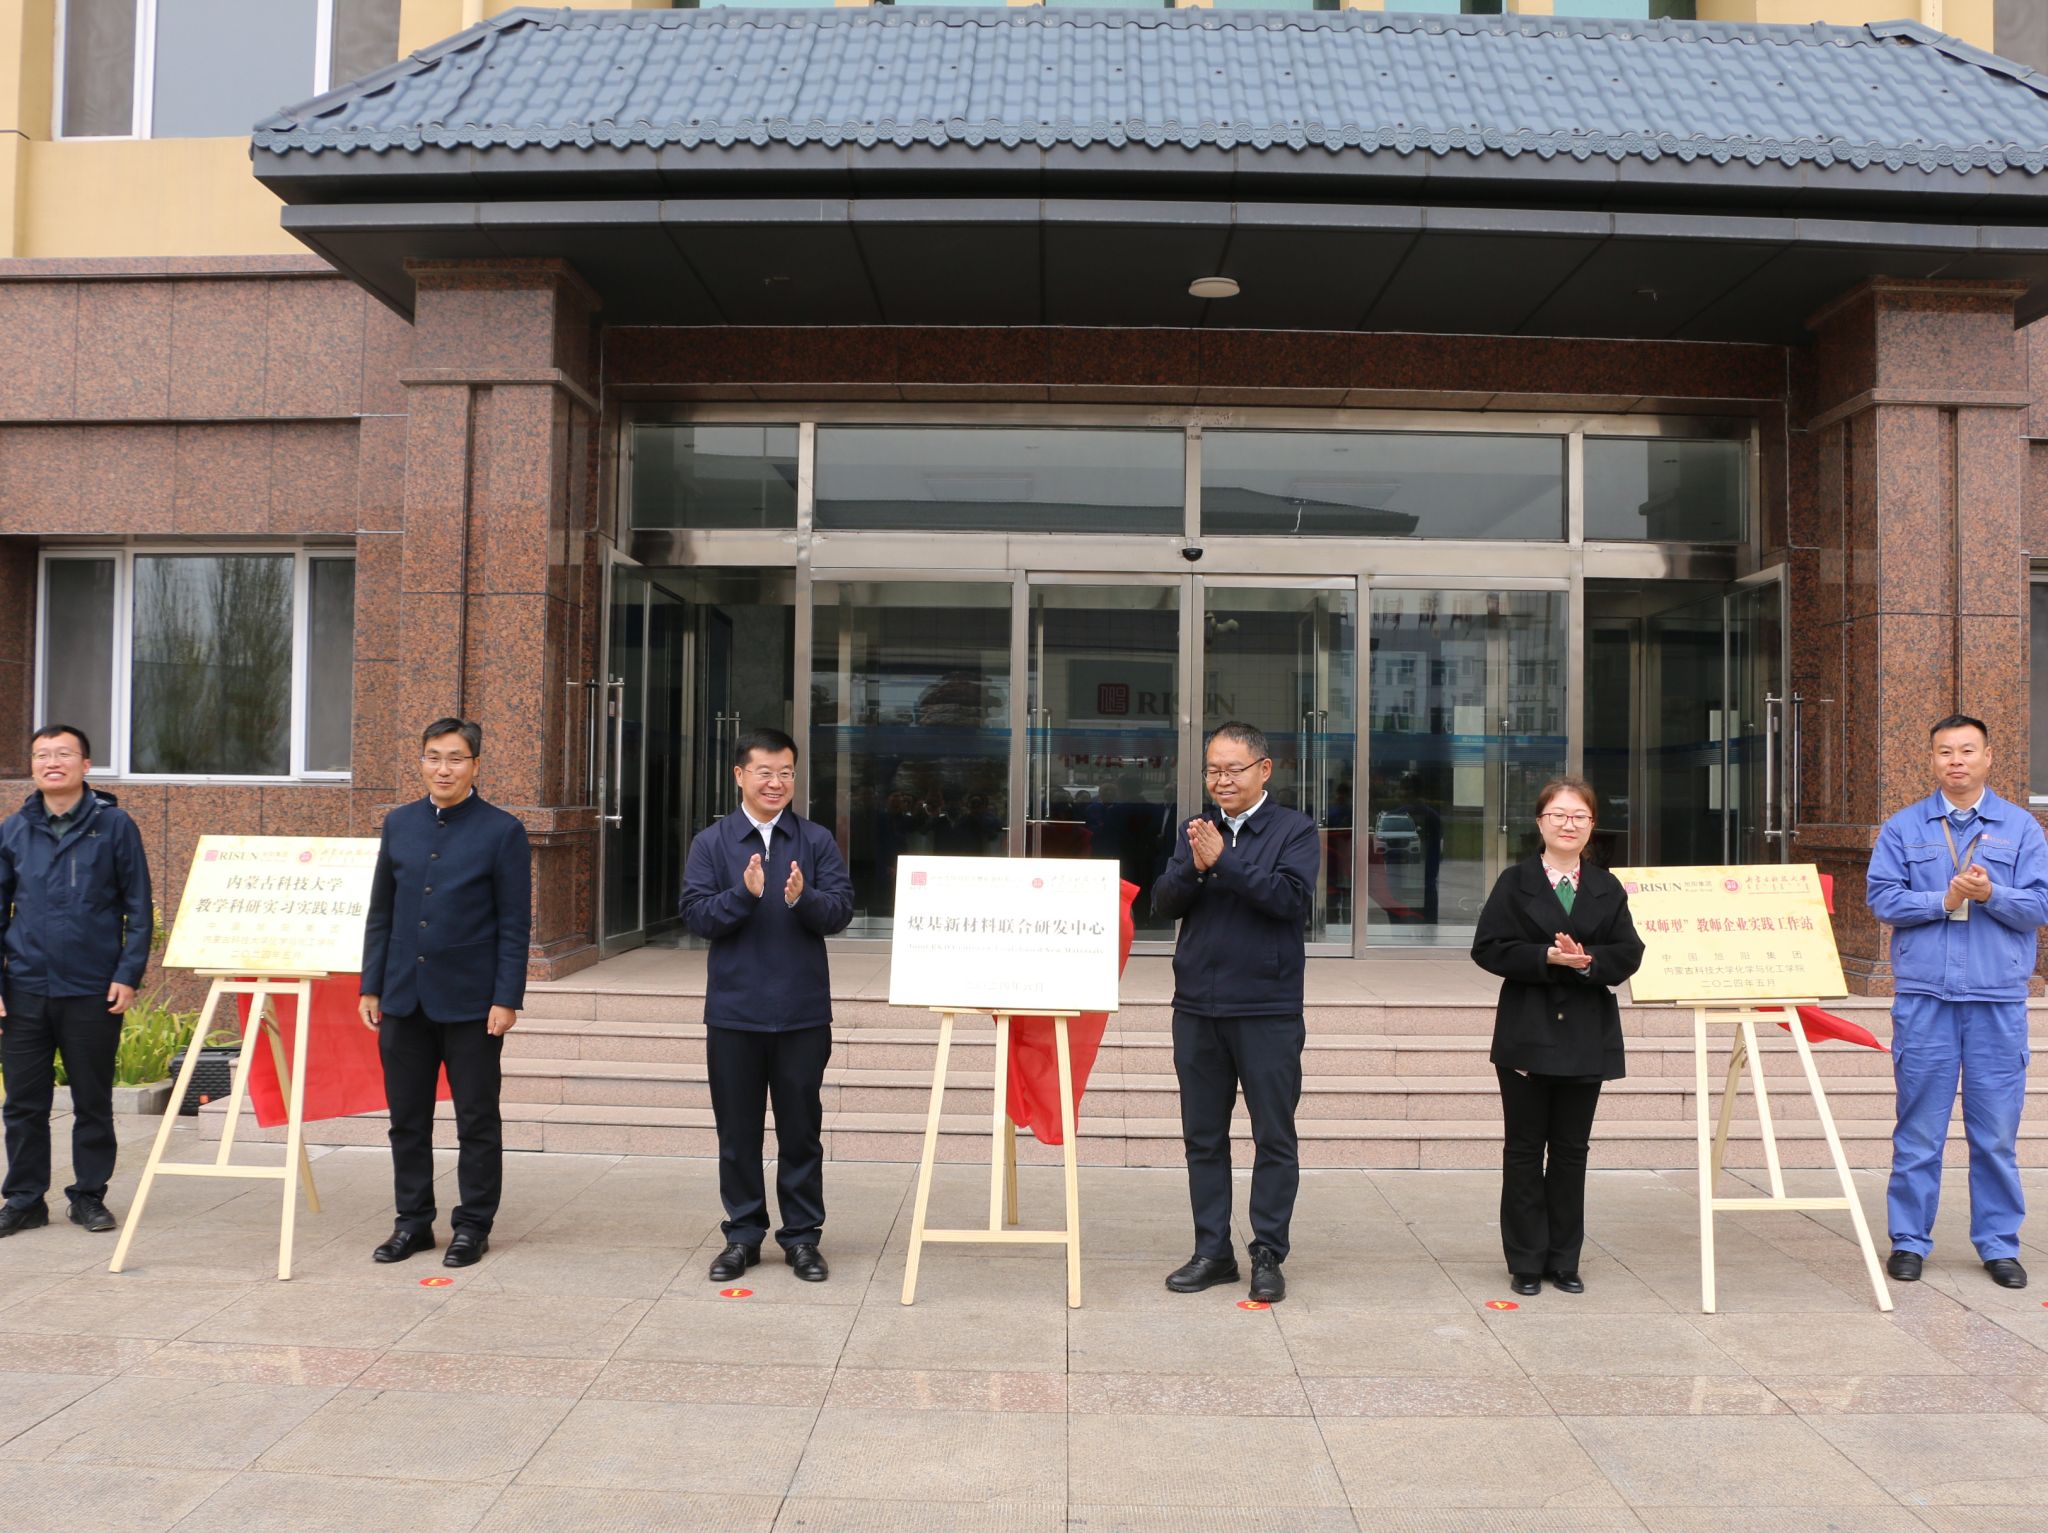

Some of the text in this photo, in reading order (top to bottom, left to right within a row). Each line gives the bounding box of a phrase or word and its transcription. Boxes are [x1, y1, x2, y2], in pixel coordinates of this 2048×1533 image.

[219, 851, 258, 861] RISUN
[226, 875, 344, 892] 内蒙古科技大学
[1640, 882, 1682, 892] RISUN
[195, 898, 363, 916] 教学科研实习实践基地
[907, 915, 1105, 935] 煤基新材料联合研发中心
